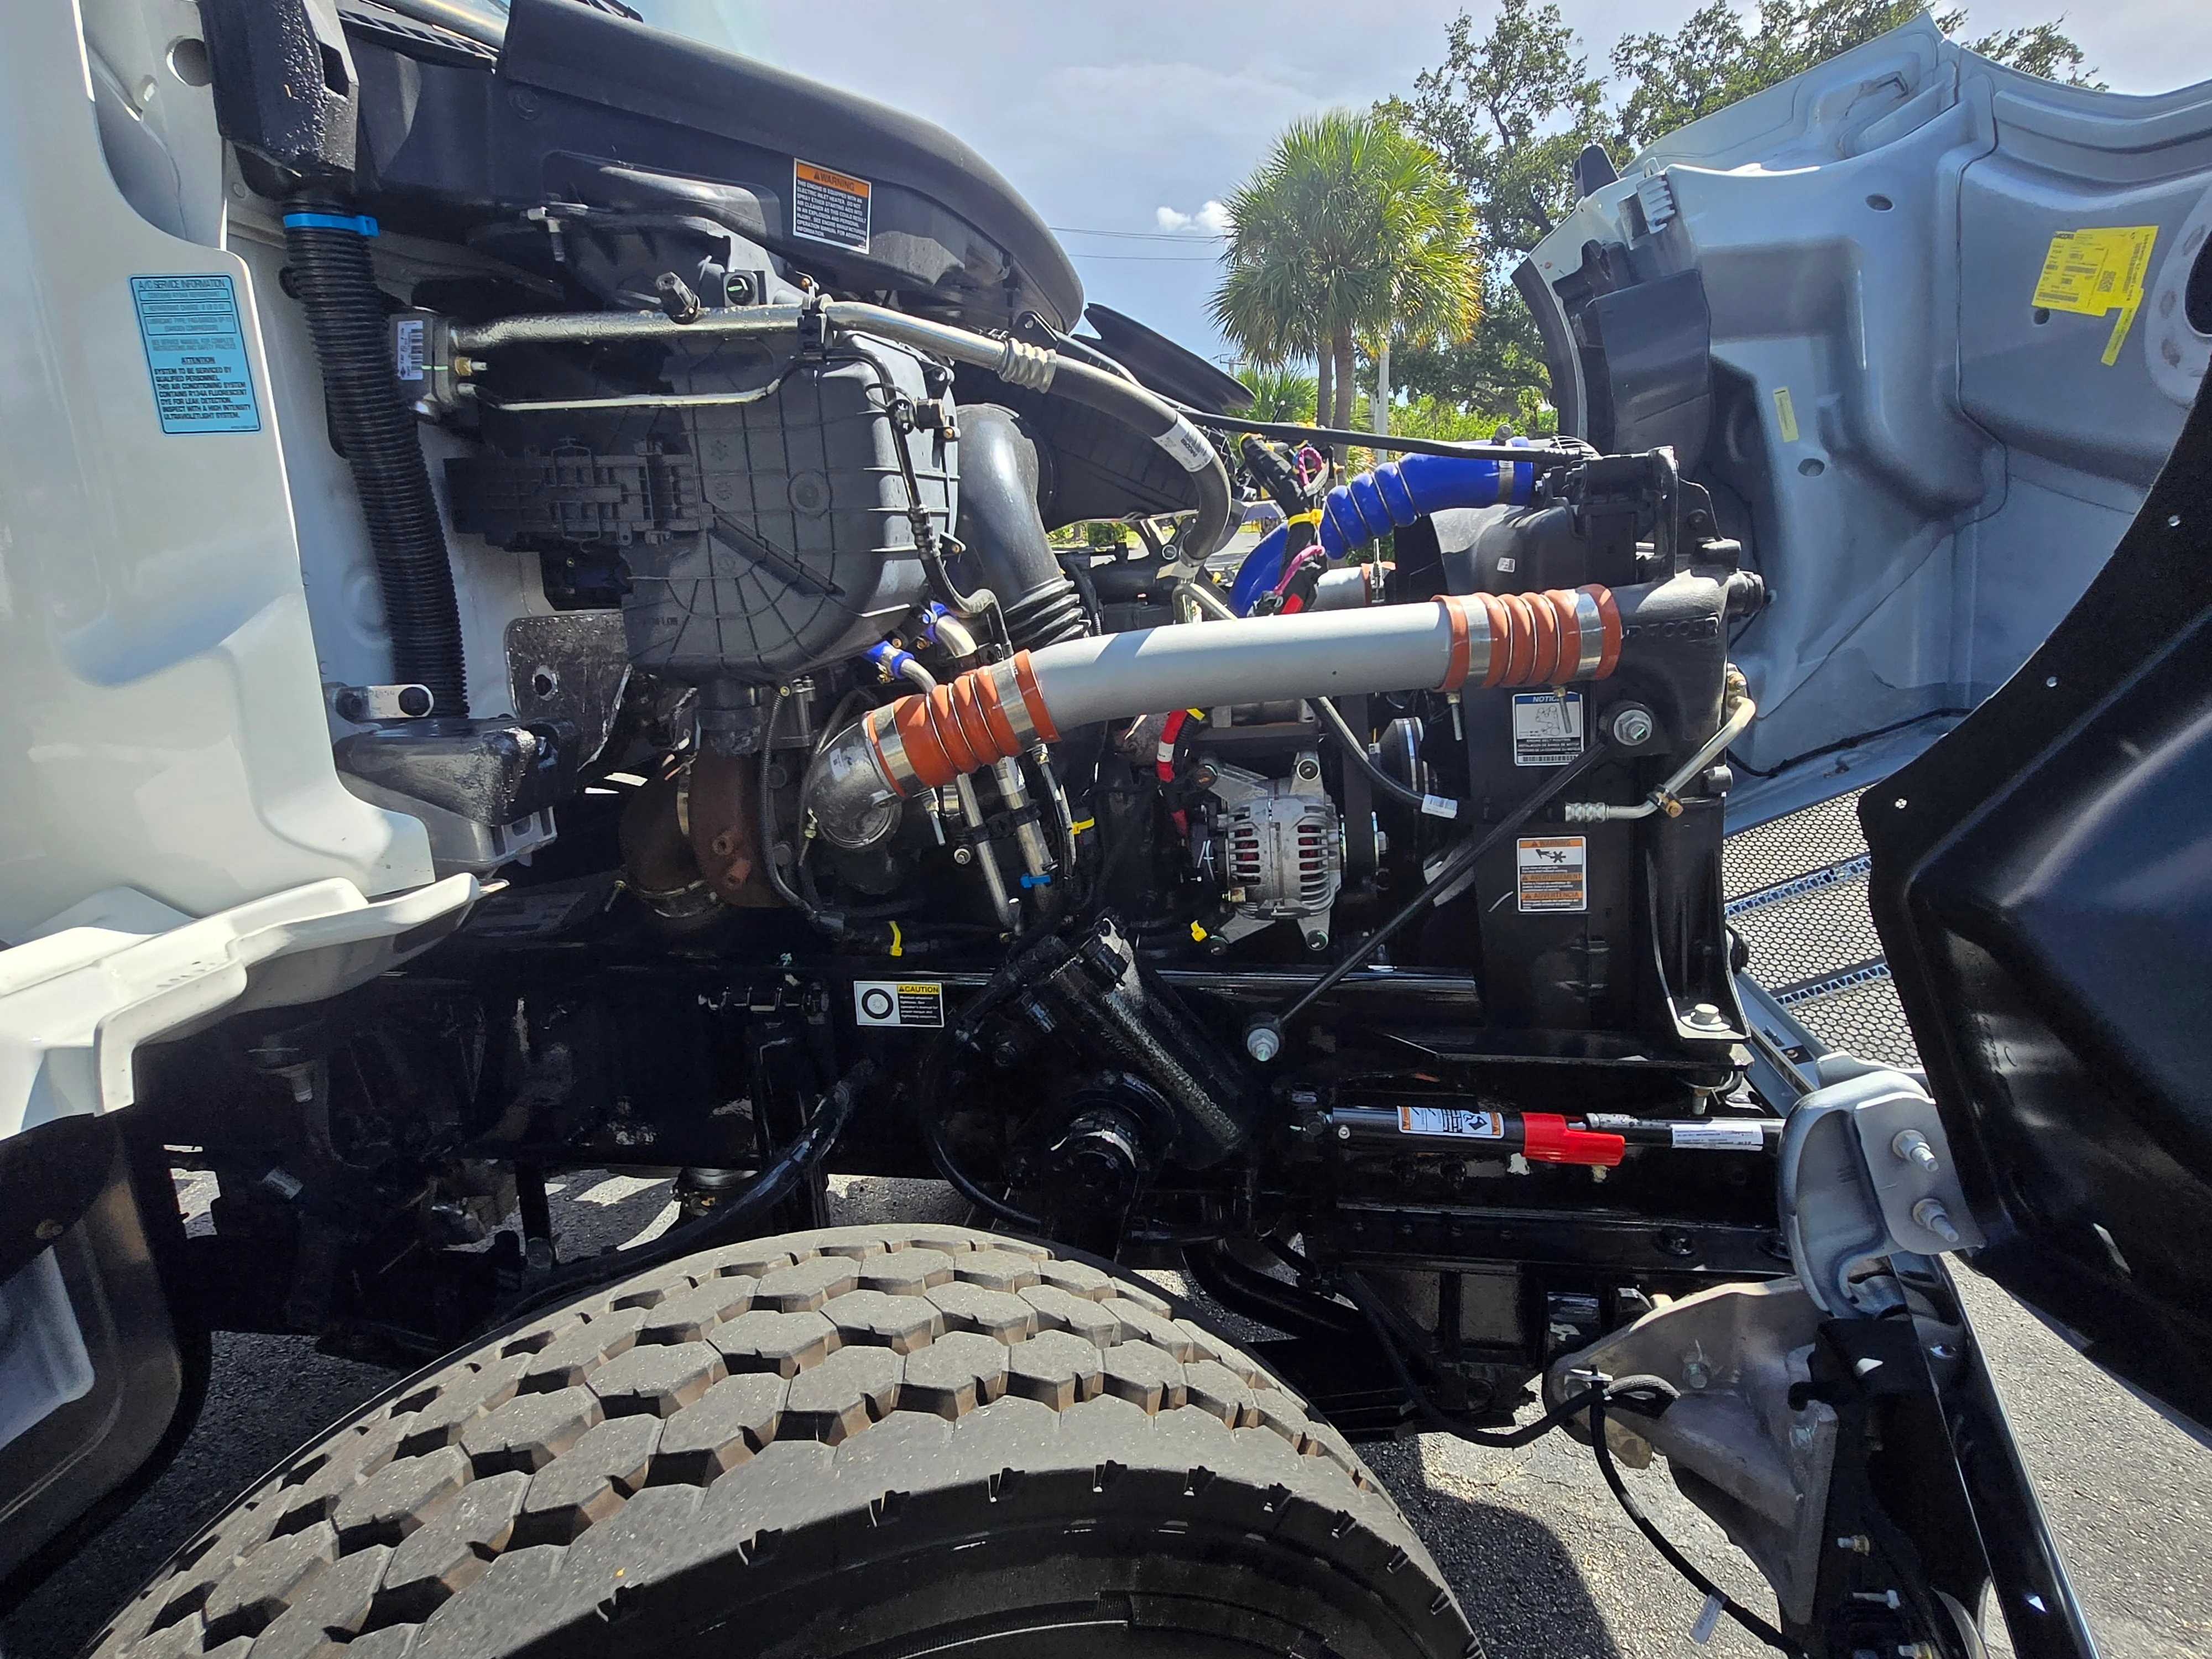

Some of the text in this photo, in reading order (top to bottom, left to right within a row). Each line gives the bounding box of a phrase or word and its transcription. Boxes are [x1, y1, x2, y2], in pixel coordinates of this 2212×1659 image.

[820, 173, 854, 191] WARNING
[797, 187, 816, 196] ELECTRIC
[827, 189, 846, 199] EQUIPPED
[797, 193, 810, 202] SPRAY
[805, 202, 823, 211] CLEANER
[797, 220, 819, 229] OPERATION
[139, 279, 225, 289] A/C SERVICE INFORMATION
